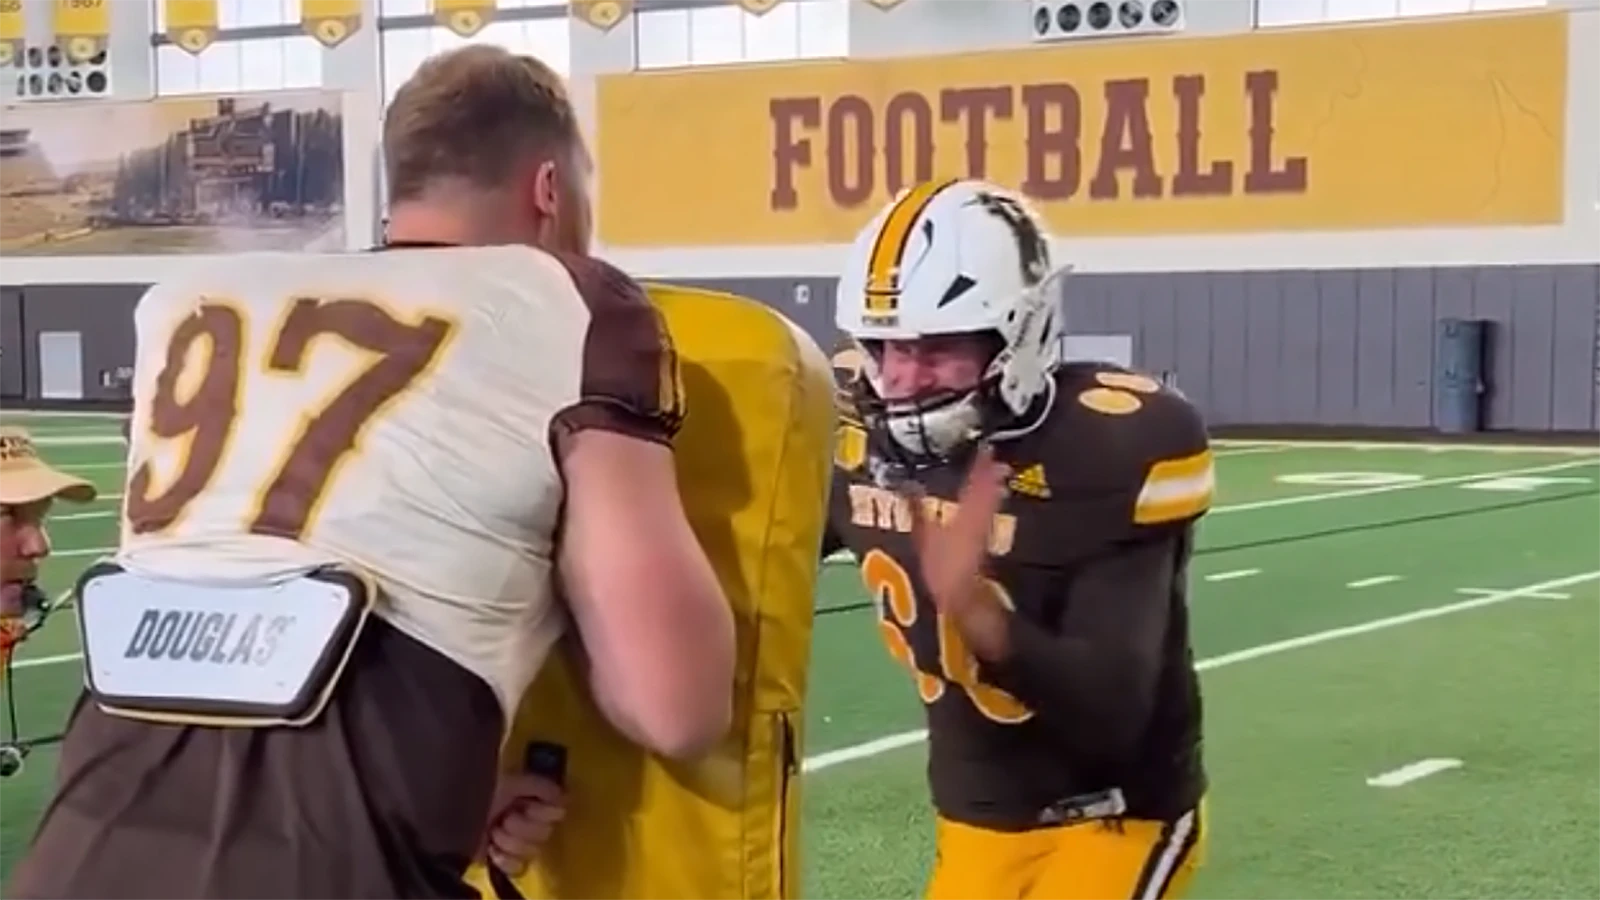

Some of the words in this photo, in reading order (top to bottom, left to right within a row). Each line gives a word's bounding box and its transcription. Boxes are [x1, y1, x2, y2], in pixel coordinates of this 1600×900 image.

[769, 70, 1308, 210] FOOTBALL
[126, 295, 457, 538] 97
[124, 608, 289, 666] DOUGLAS
